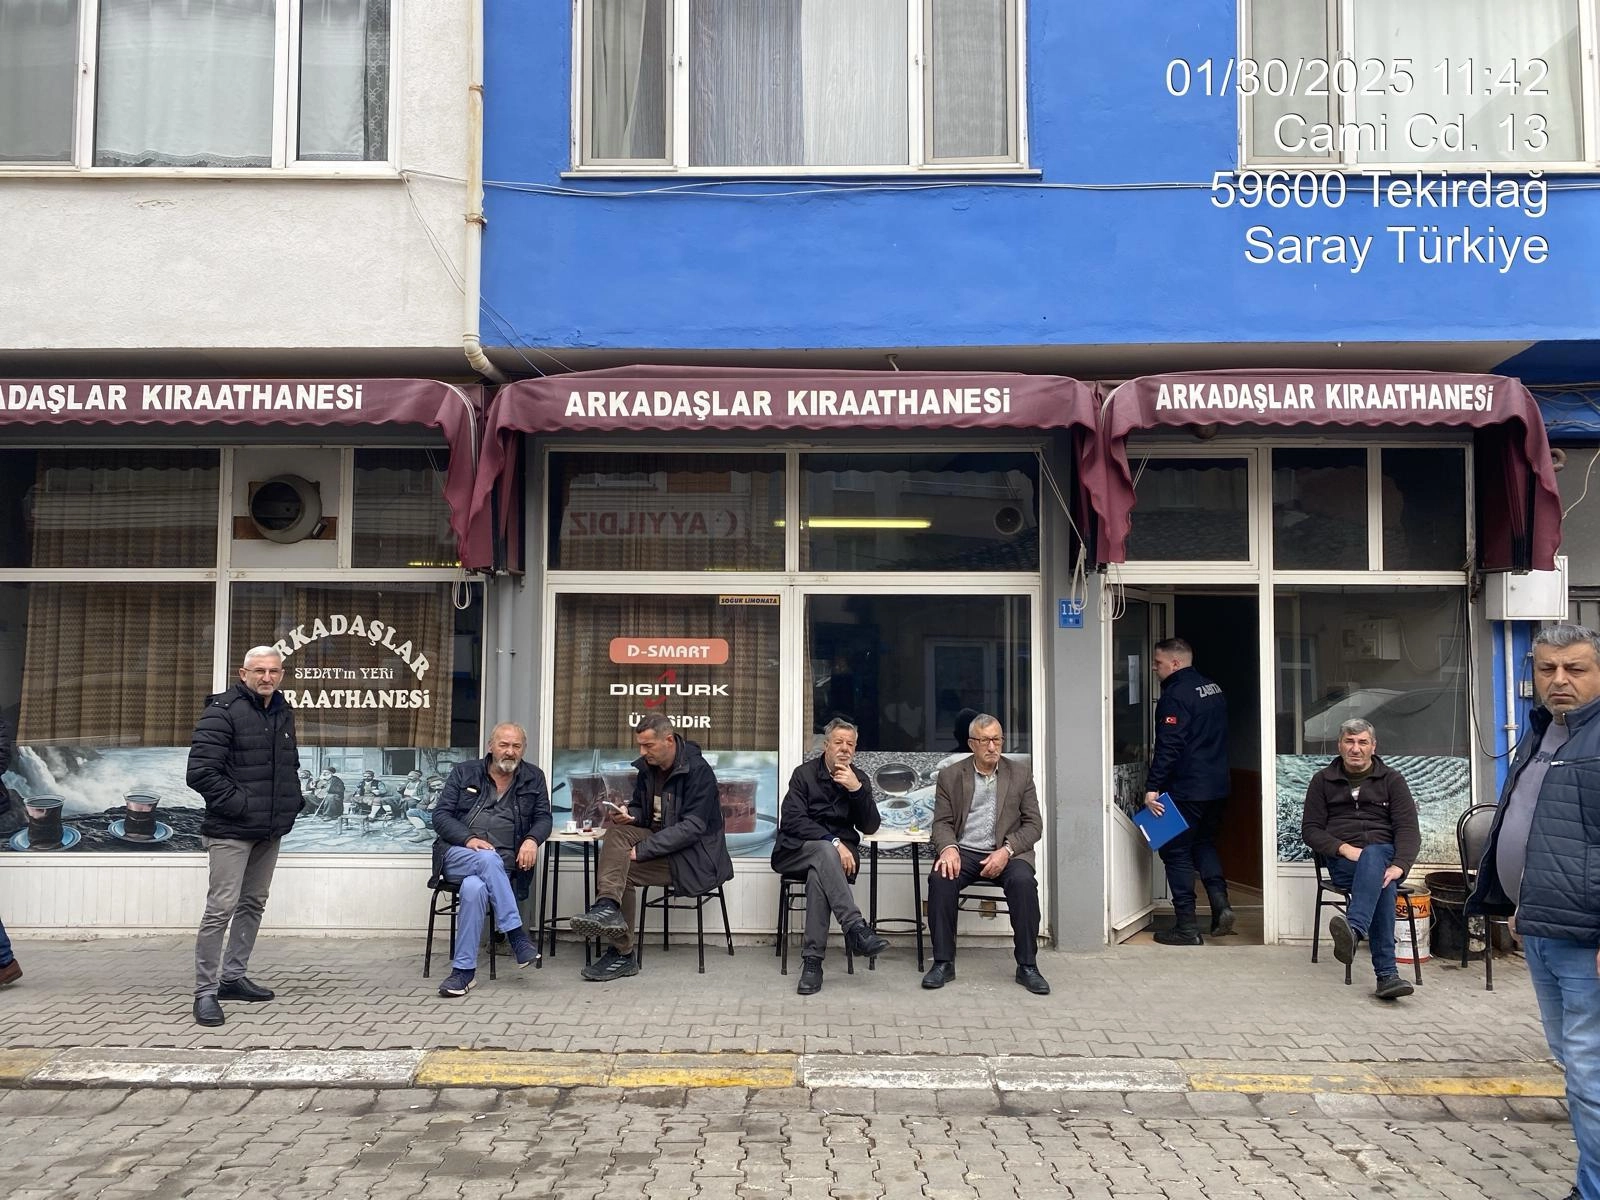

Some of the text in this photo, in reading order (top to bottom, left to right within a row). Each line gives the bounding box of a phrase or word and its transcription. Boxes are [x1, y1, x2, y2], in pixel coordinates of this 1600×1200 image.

[564, 390, 773, 421] ARKADAŞLAR
[1155, 383, 1316, 414] ARKADAŞLAR
[271, 614, 430, 681] RKADAŞLAR
[627, 644, 710, 658] D-SMART
[609, 683, 729, 696] DIGITURK
